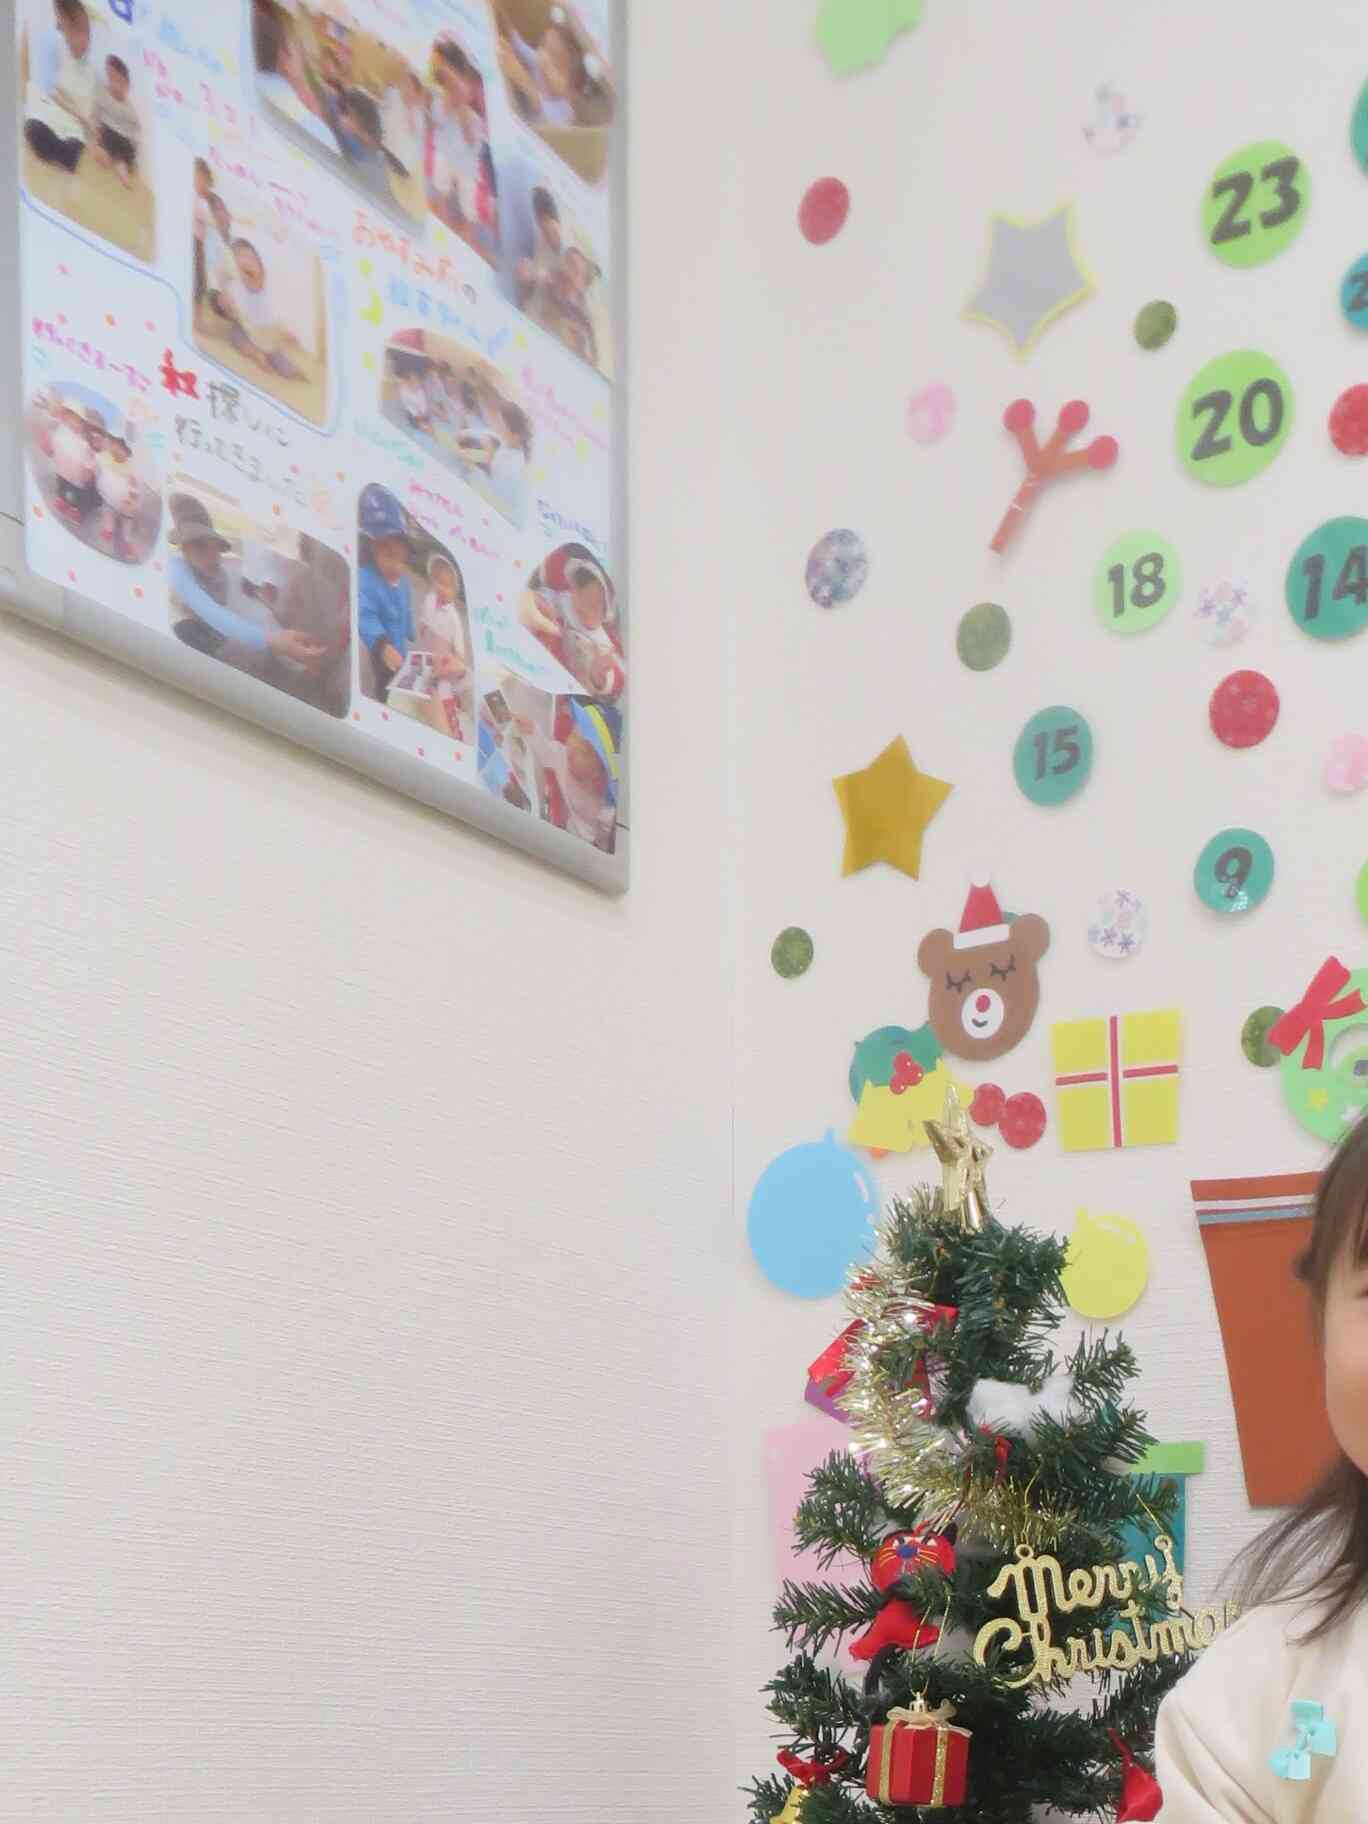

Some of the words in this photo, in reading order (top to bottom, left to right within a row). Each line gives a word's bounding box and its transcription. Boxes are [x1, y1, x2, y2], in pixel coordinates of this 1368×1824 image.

[1210, 156, 1301, 245] 23
[1192, 378, 1284, 461] 20
[1108, 553, 1167, 616] 18
[1034, 726, 1081, 781] 15
[1213, 847, 1253, 899] 9
[986, 1548, 1185, 1622] Merry
